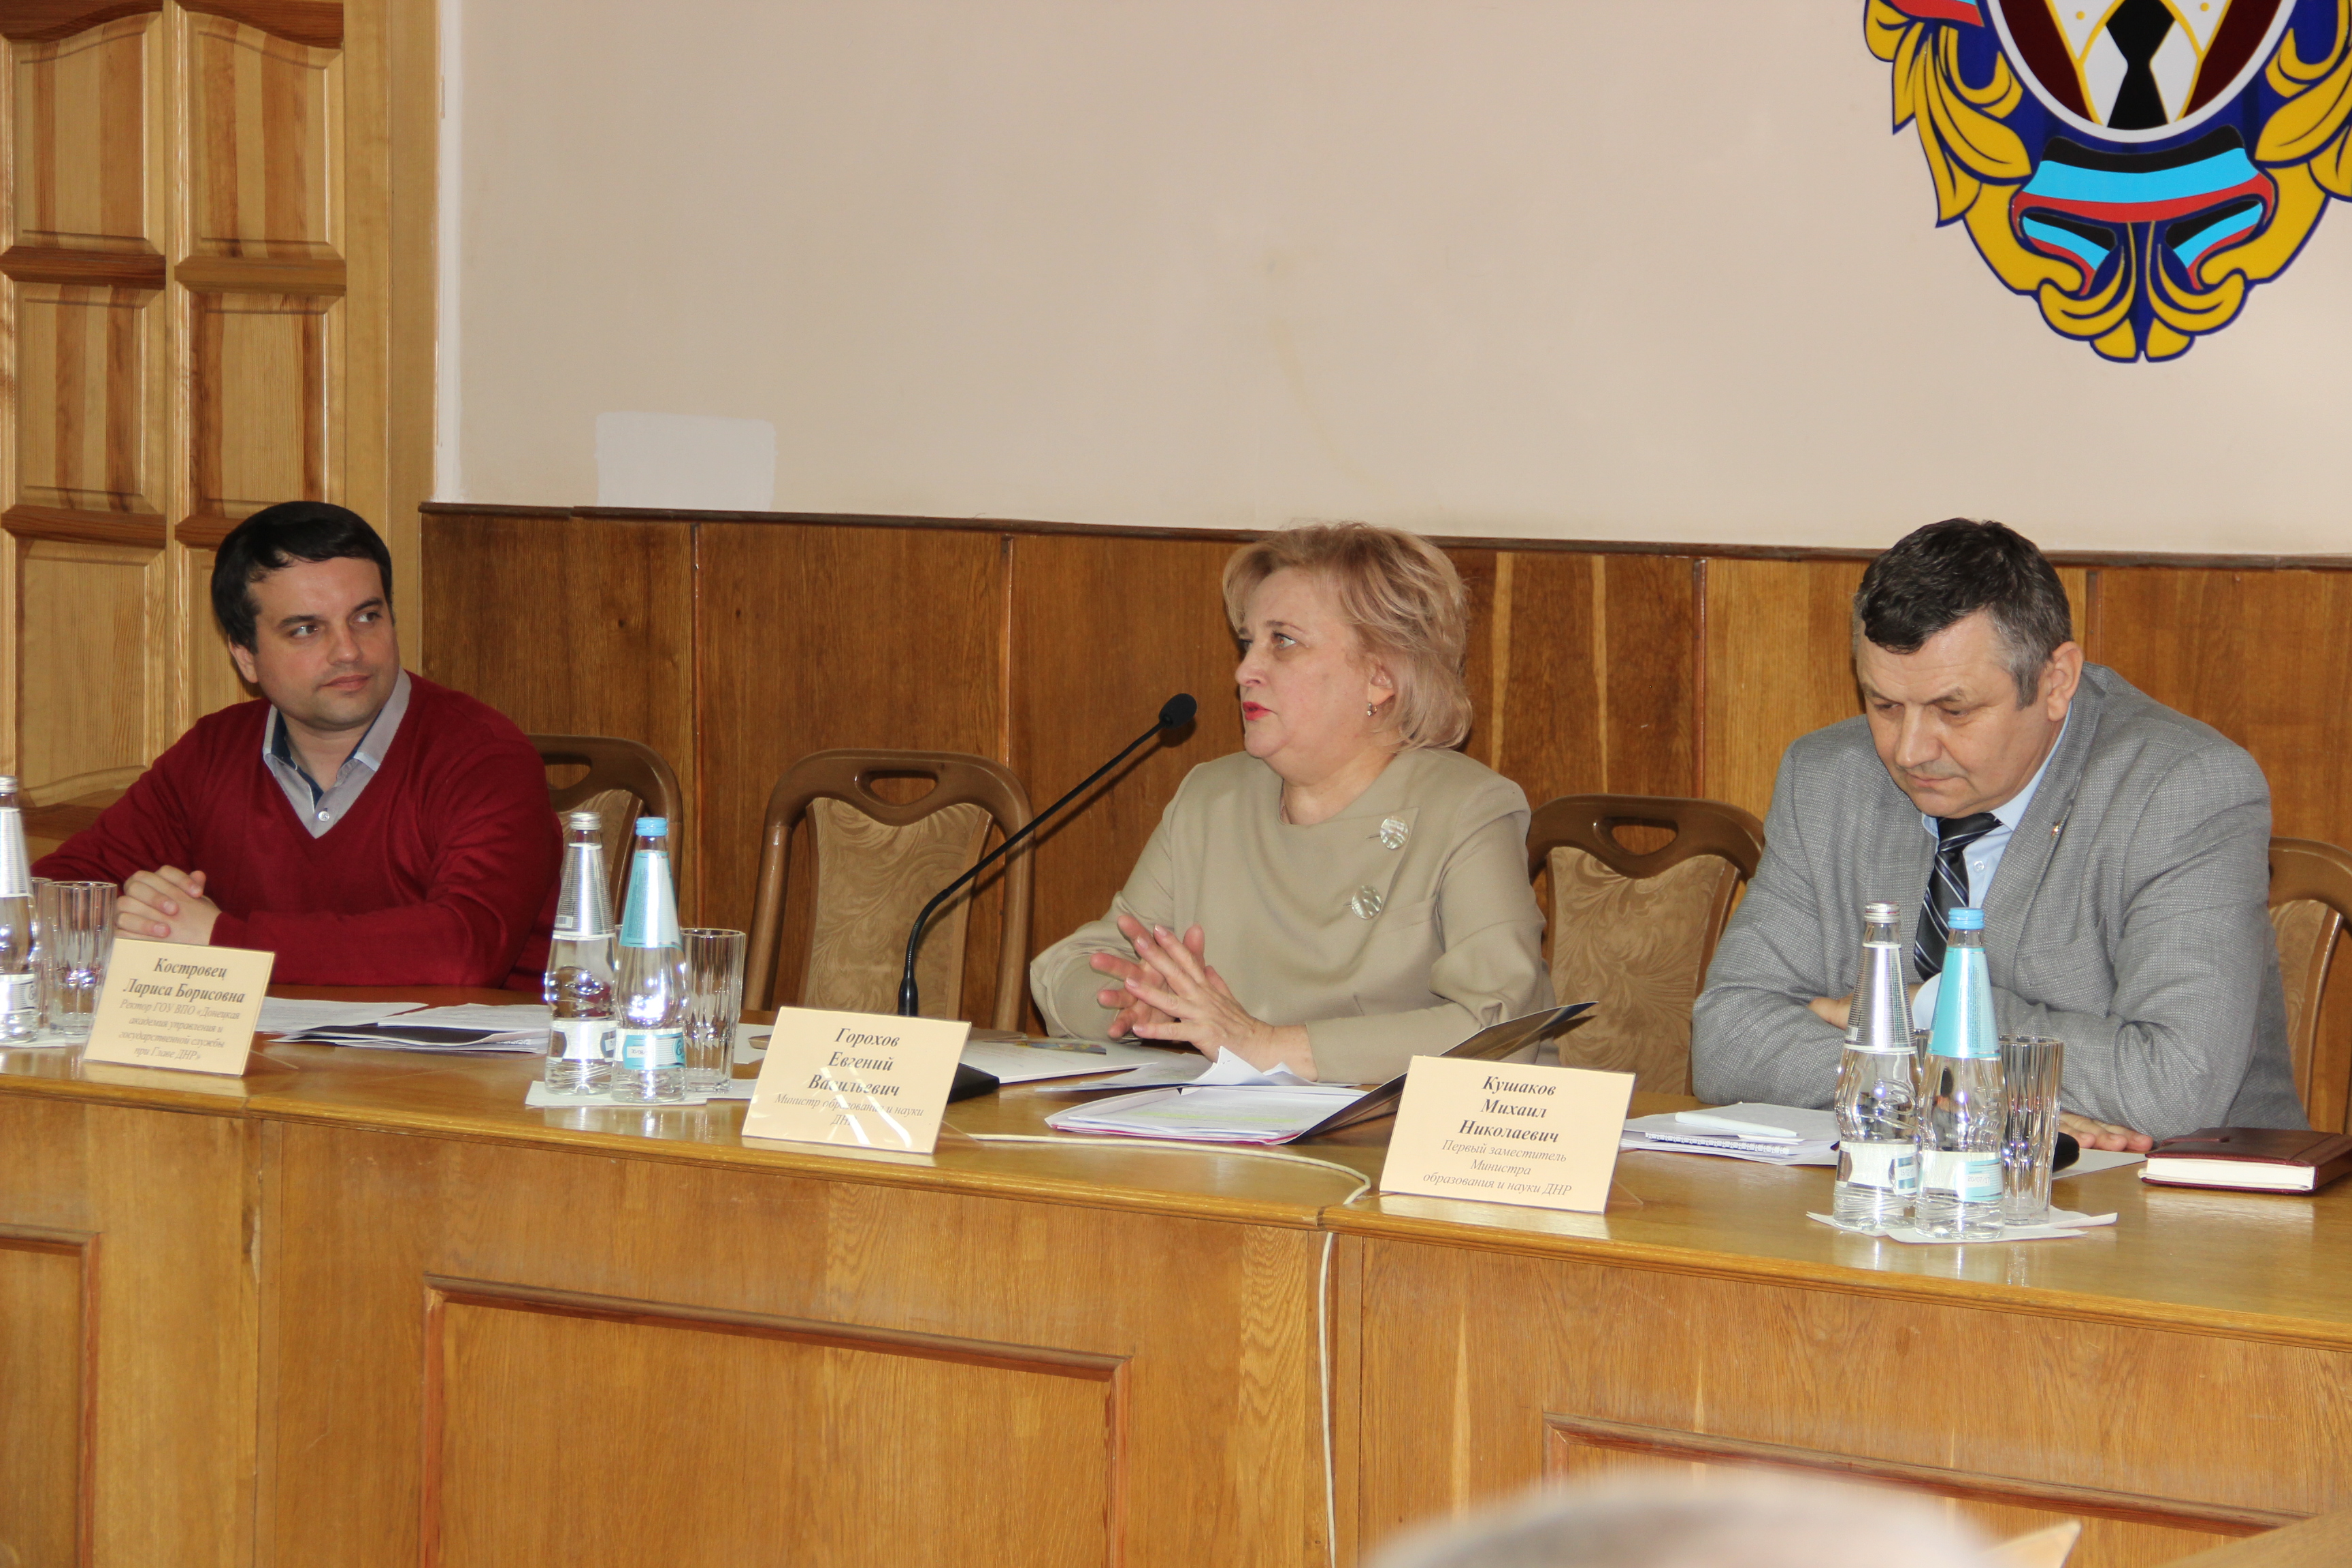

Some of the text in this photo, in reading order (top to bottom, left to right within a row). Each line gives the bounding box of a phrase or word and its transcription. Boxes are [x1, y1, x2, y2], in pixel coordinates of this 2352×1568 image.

[153, 958, 227, 981] Костровец
[123, 979, 246, 1002] Лариса Борисовна
[120, 999, 152, 1012] Ректор
[152, 1002, 174, 1012] ГОУ
[174, 1005, 195, 1015] ВПО
[129, 1017, 168, 1028] академия
[169, 1021, 216, 1032] управления
[119, 1032, 225, 1048] государственной службы
[834, 1028, 900, 1047] Горохов
[134, 1048, 149, 1056] при
[151, 1047, 174, 1058] Главе
[828, 1051, 894, 1071] Евгений
[1482, 1076, 1556, 1096] Кушаков
[774, 1094, 820, 1108] Министр
[894, 1107, 924, 1117] науки
[1480, 1098, 1547, 1119] Михаил
[1458, 1120, 1560, 1143] Николаевич
[1441, 1139, 1567, 1162] Первый заместитель
[1471, 1159, 1531, 1176] Министра
[1423, 1173, 1572, 1196] образования и науки ДНР
